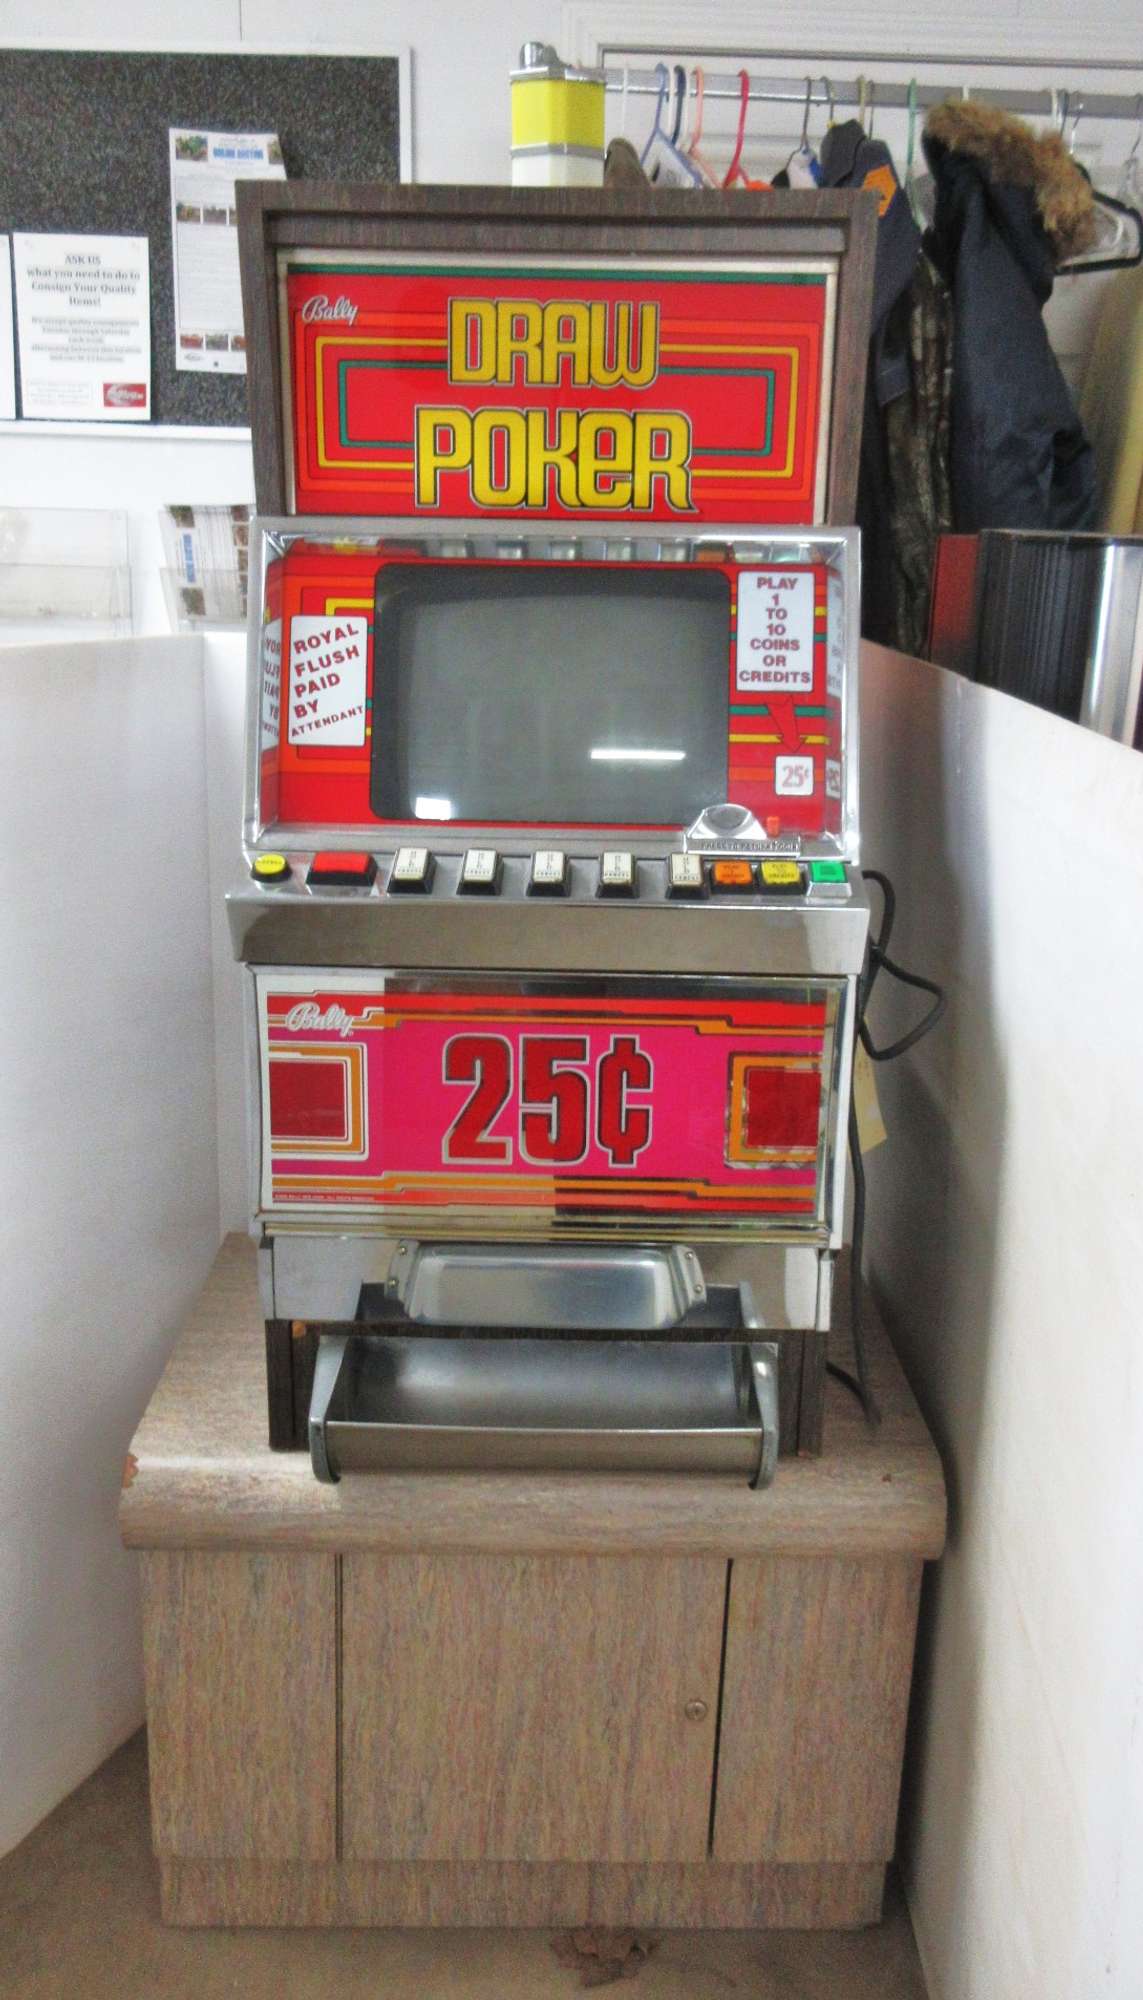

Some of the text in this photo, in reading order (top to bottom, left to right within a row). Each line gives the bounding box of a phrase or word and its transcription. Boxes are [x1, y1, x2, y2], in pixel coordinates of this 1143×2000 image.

[65, 255, 85, 265] ASK
[27, 268, 140, 280] what you need to do to
[32, 281, 136, 295] Consign Your Quality
[302, 296, 358, 325] Bally
[448, 297, 660, 391] DRAW
[757, 577, 798, 590] PLAY
[772, 593, 780, 606] 1
[766, 608, 787, 620] TO
[766, 623, 786, 636] 10
[293, 624, 359, 654] ROYAL
[750, 638, 800, 651] COINS
[294, 645, 360, 677] FLUSH
[762, 655, 787, 667] OR
[739, 670, 811, 683] CREDITS
[294, 673, 340, 698] PAID
[294, 699, 319, 719] BY
[291, 705, 364, 737] ATTENDANT
[285, 1001, 354, 1037] Bally
[442, 1032, 653, 1168] 25¢
